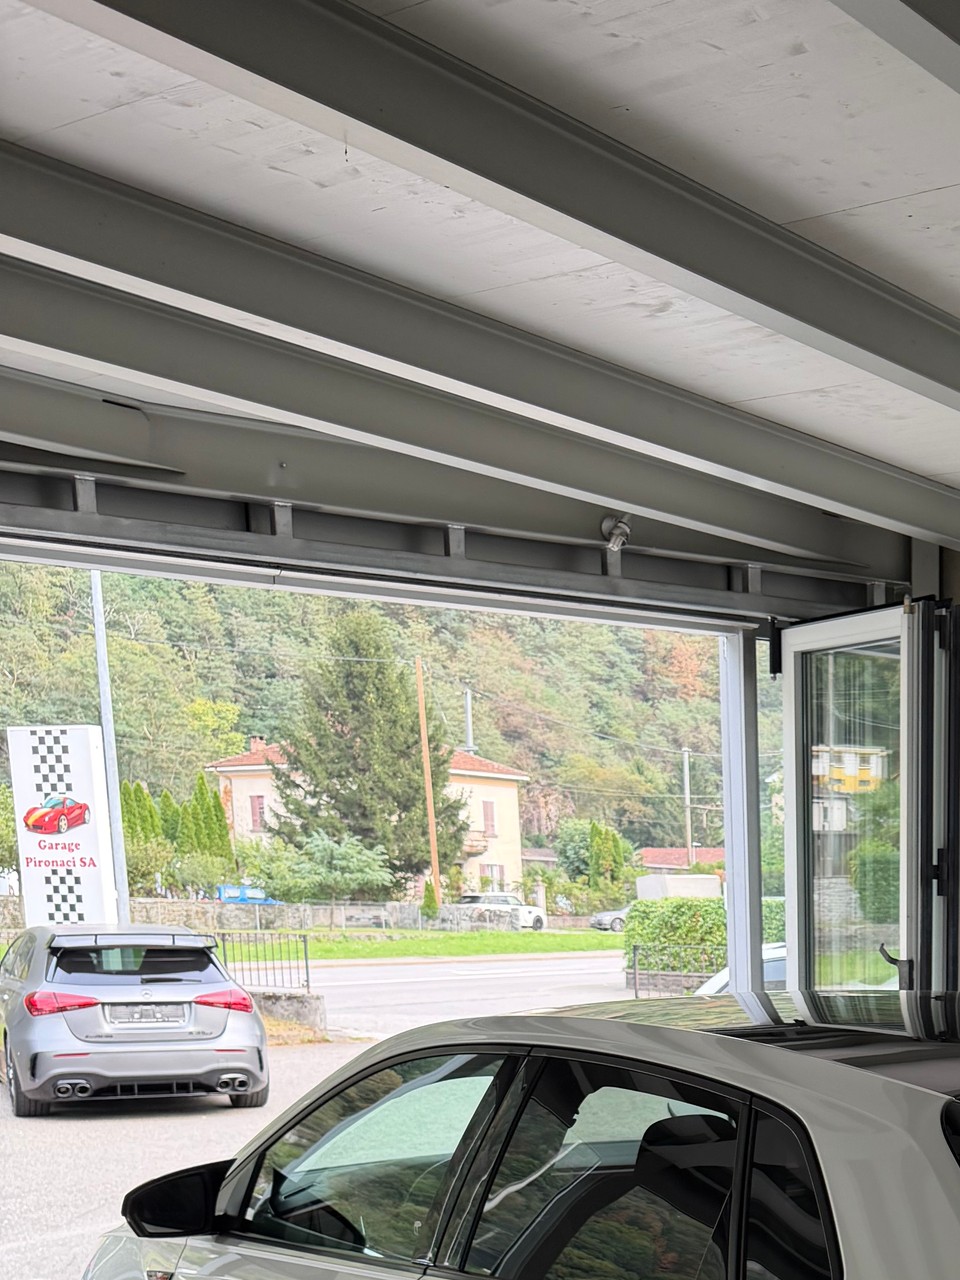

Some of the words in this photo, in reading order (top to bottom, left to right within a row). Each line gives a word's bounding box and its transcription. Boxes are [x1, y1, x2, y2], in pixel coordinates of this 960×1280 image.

[38, 839, 81, 853] Garage
[25, 857, 77, 868] Pironaci
[79, 857, 97, 868] SA
